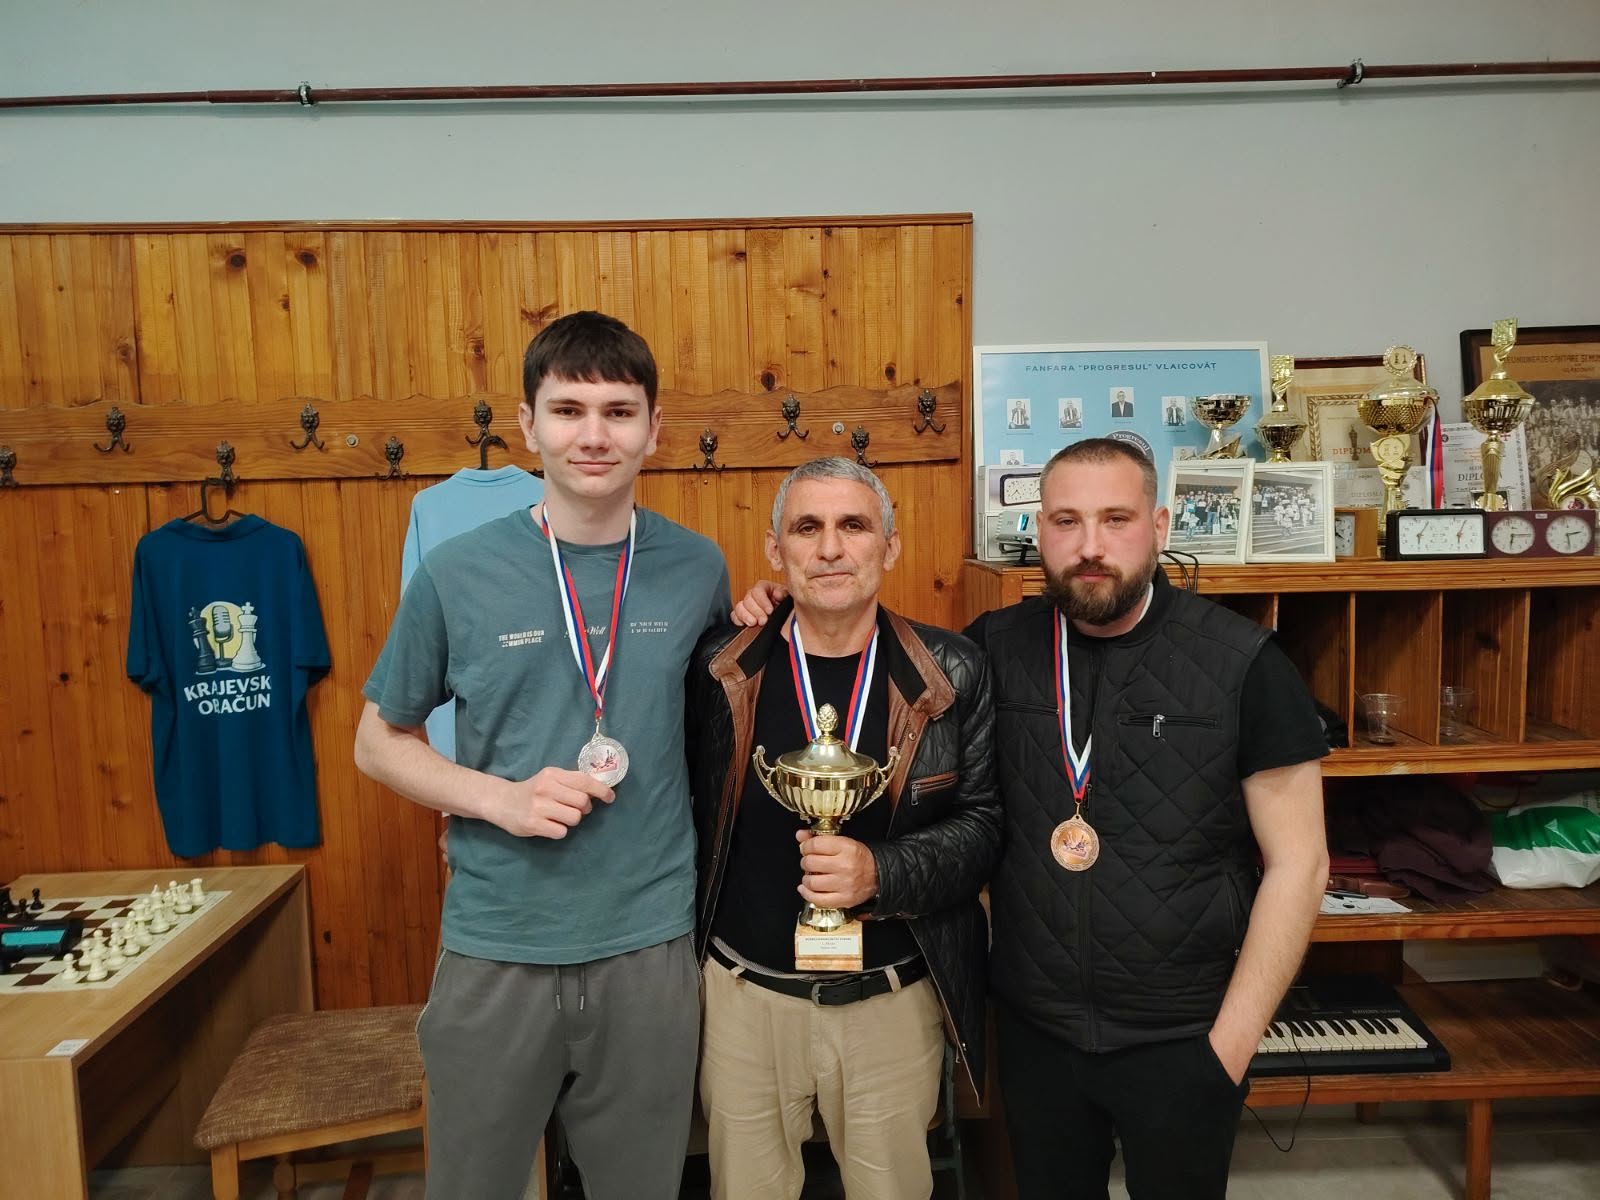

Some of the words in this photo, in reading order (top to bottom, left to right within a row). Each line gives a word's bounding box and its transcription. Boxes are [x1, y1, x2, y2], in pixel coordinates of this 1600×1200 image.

[1025, 364, 1076, 373] FANFARA
[1078, 363, 1152, 371] "PROGRESUL"
[1332, 447, 1371, 455] DIPLOM
